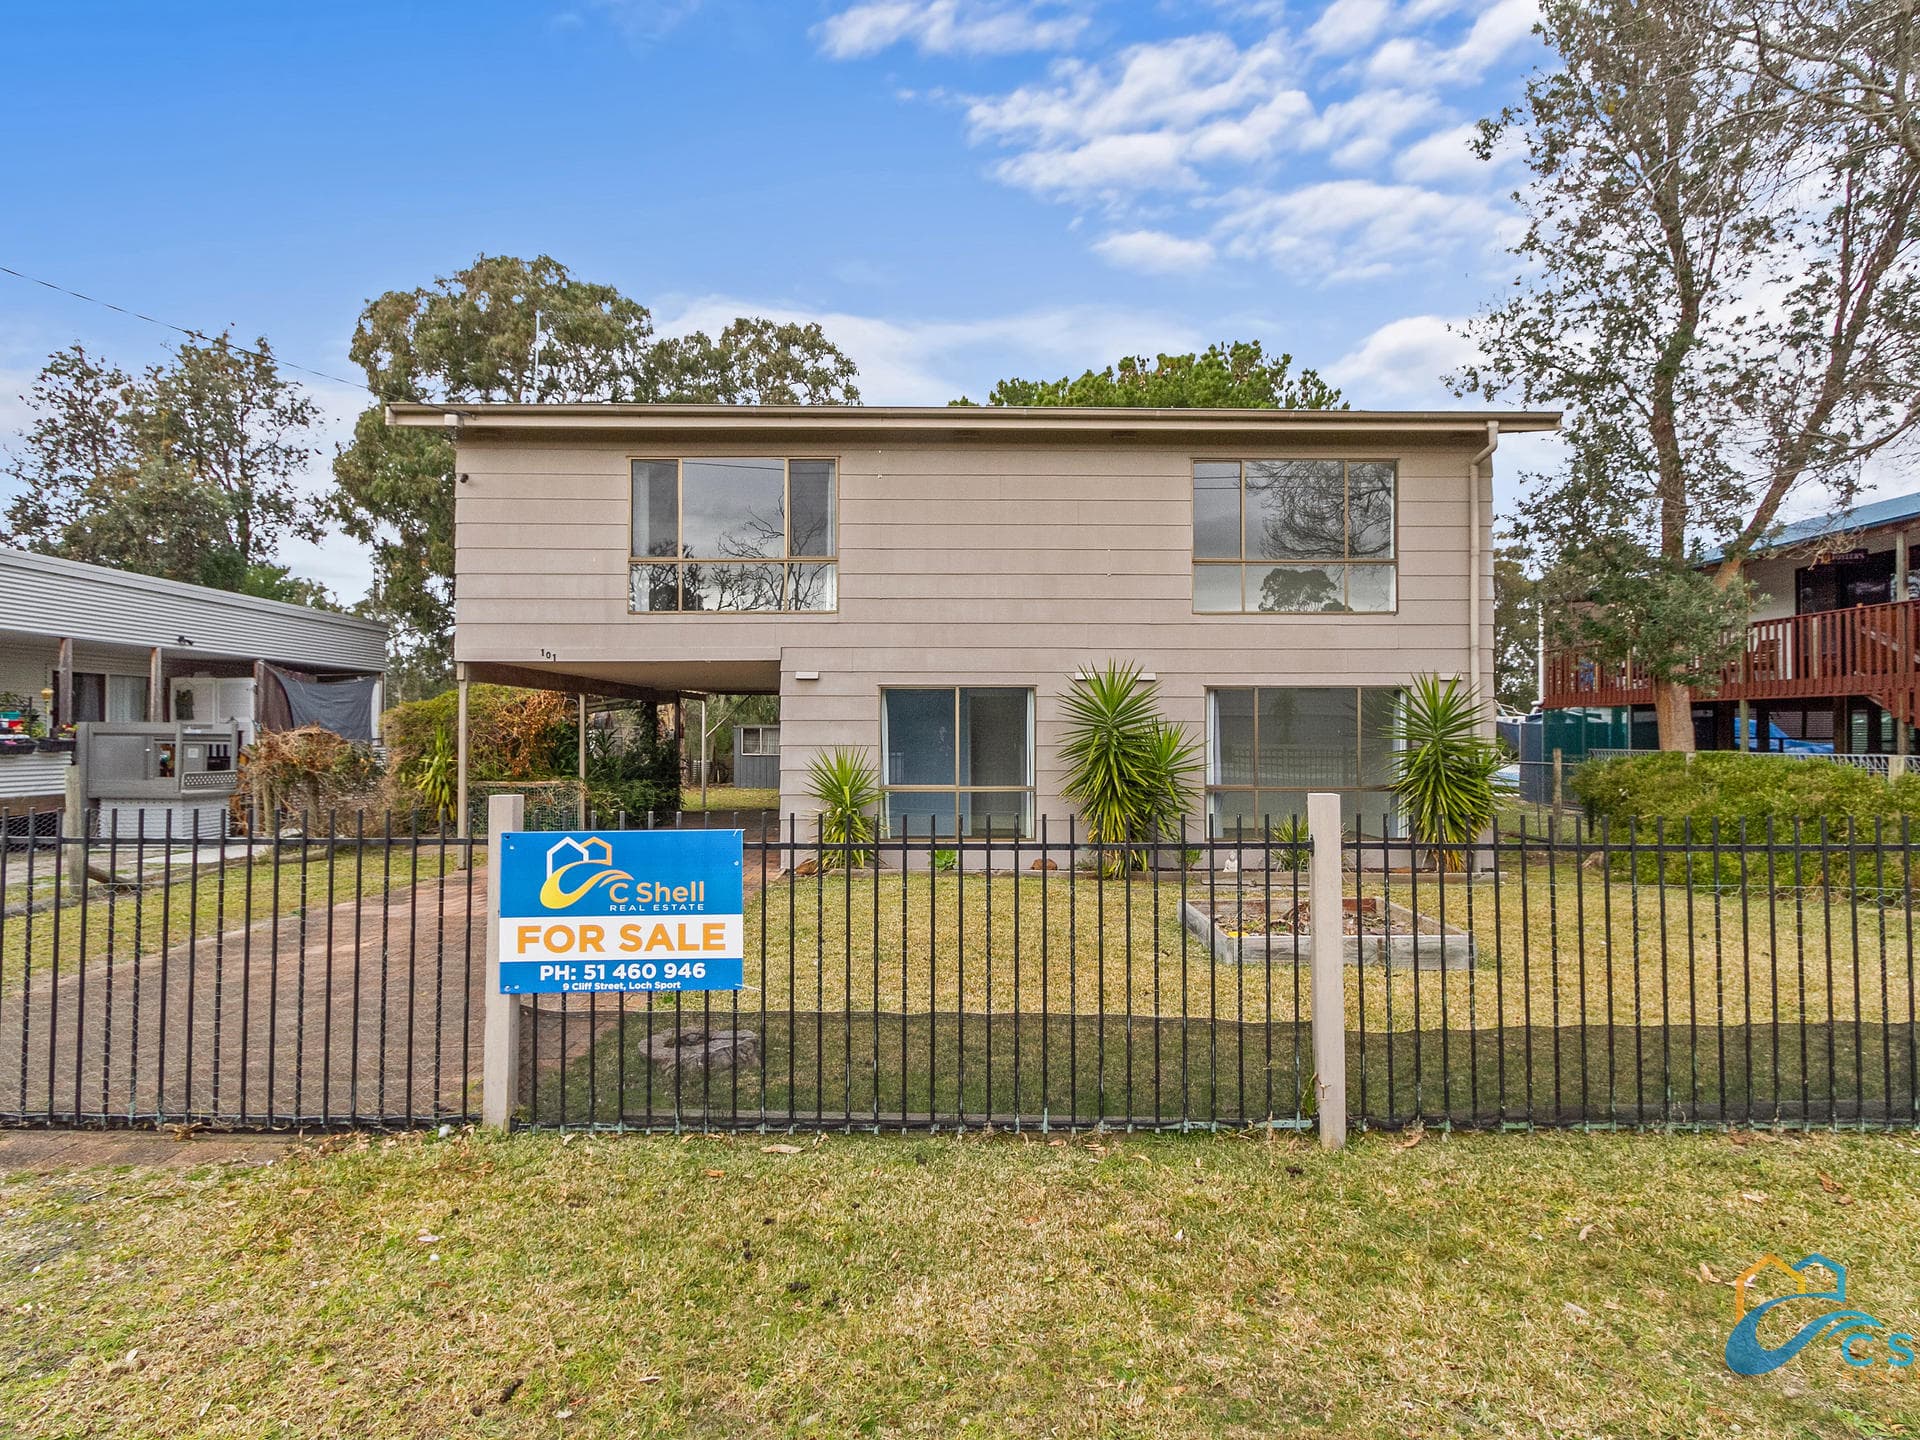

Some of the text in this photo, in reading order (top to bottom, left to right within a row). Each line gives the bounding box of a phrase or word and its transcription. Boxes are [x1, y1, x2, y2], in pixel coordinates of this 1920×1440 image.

[541, 649, 556, 662] 101
[609, 881, 705, 903] C Shell
[609, 903, 705, 912] REAL ESTATE
[517, 923, 726, 954] FOR SALE
[540, 962, 706, 981] PH: 51 460 946
[562, 980, 682, 991] 9 Cliff Street, Loch Sport
